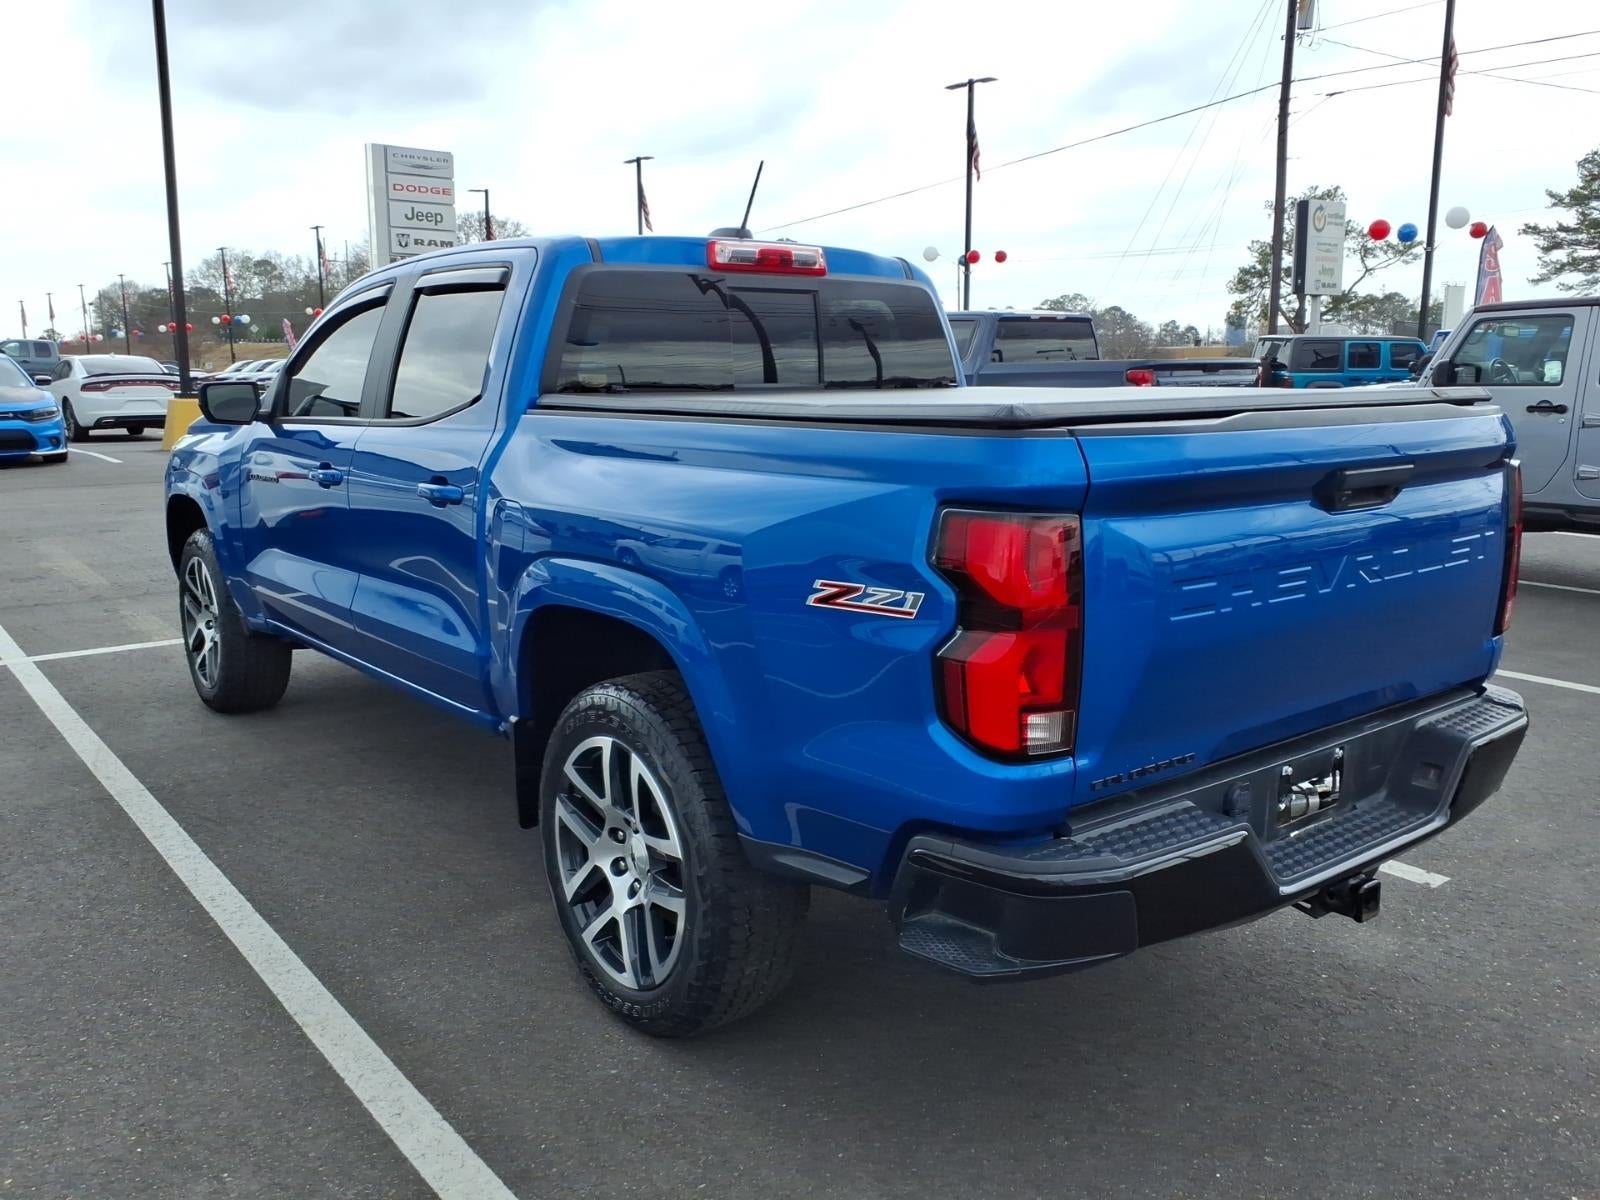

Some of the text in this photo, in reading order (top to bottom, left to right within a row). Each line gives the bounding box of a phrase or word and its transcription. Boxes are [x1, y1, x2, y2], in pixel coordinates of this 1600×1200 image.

[392, 152, 449, 164] CHRYSLER
[393, 183, 453, 196] DODGE
[404, 206, 444, 226] Jeep
[413, 238, 454, 248] RAM
[1169, 531, 1495, 621] CHEVROLET
[806, 579, 925, 619] Z71
